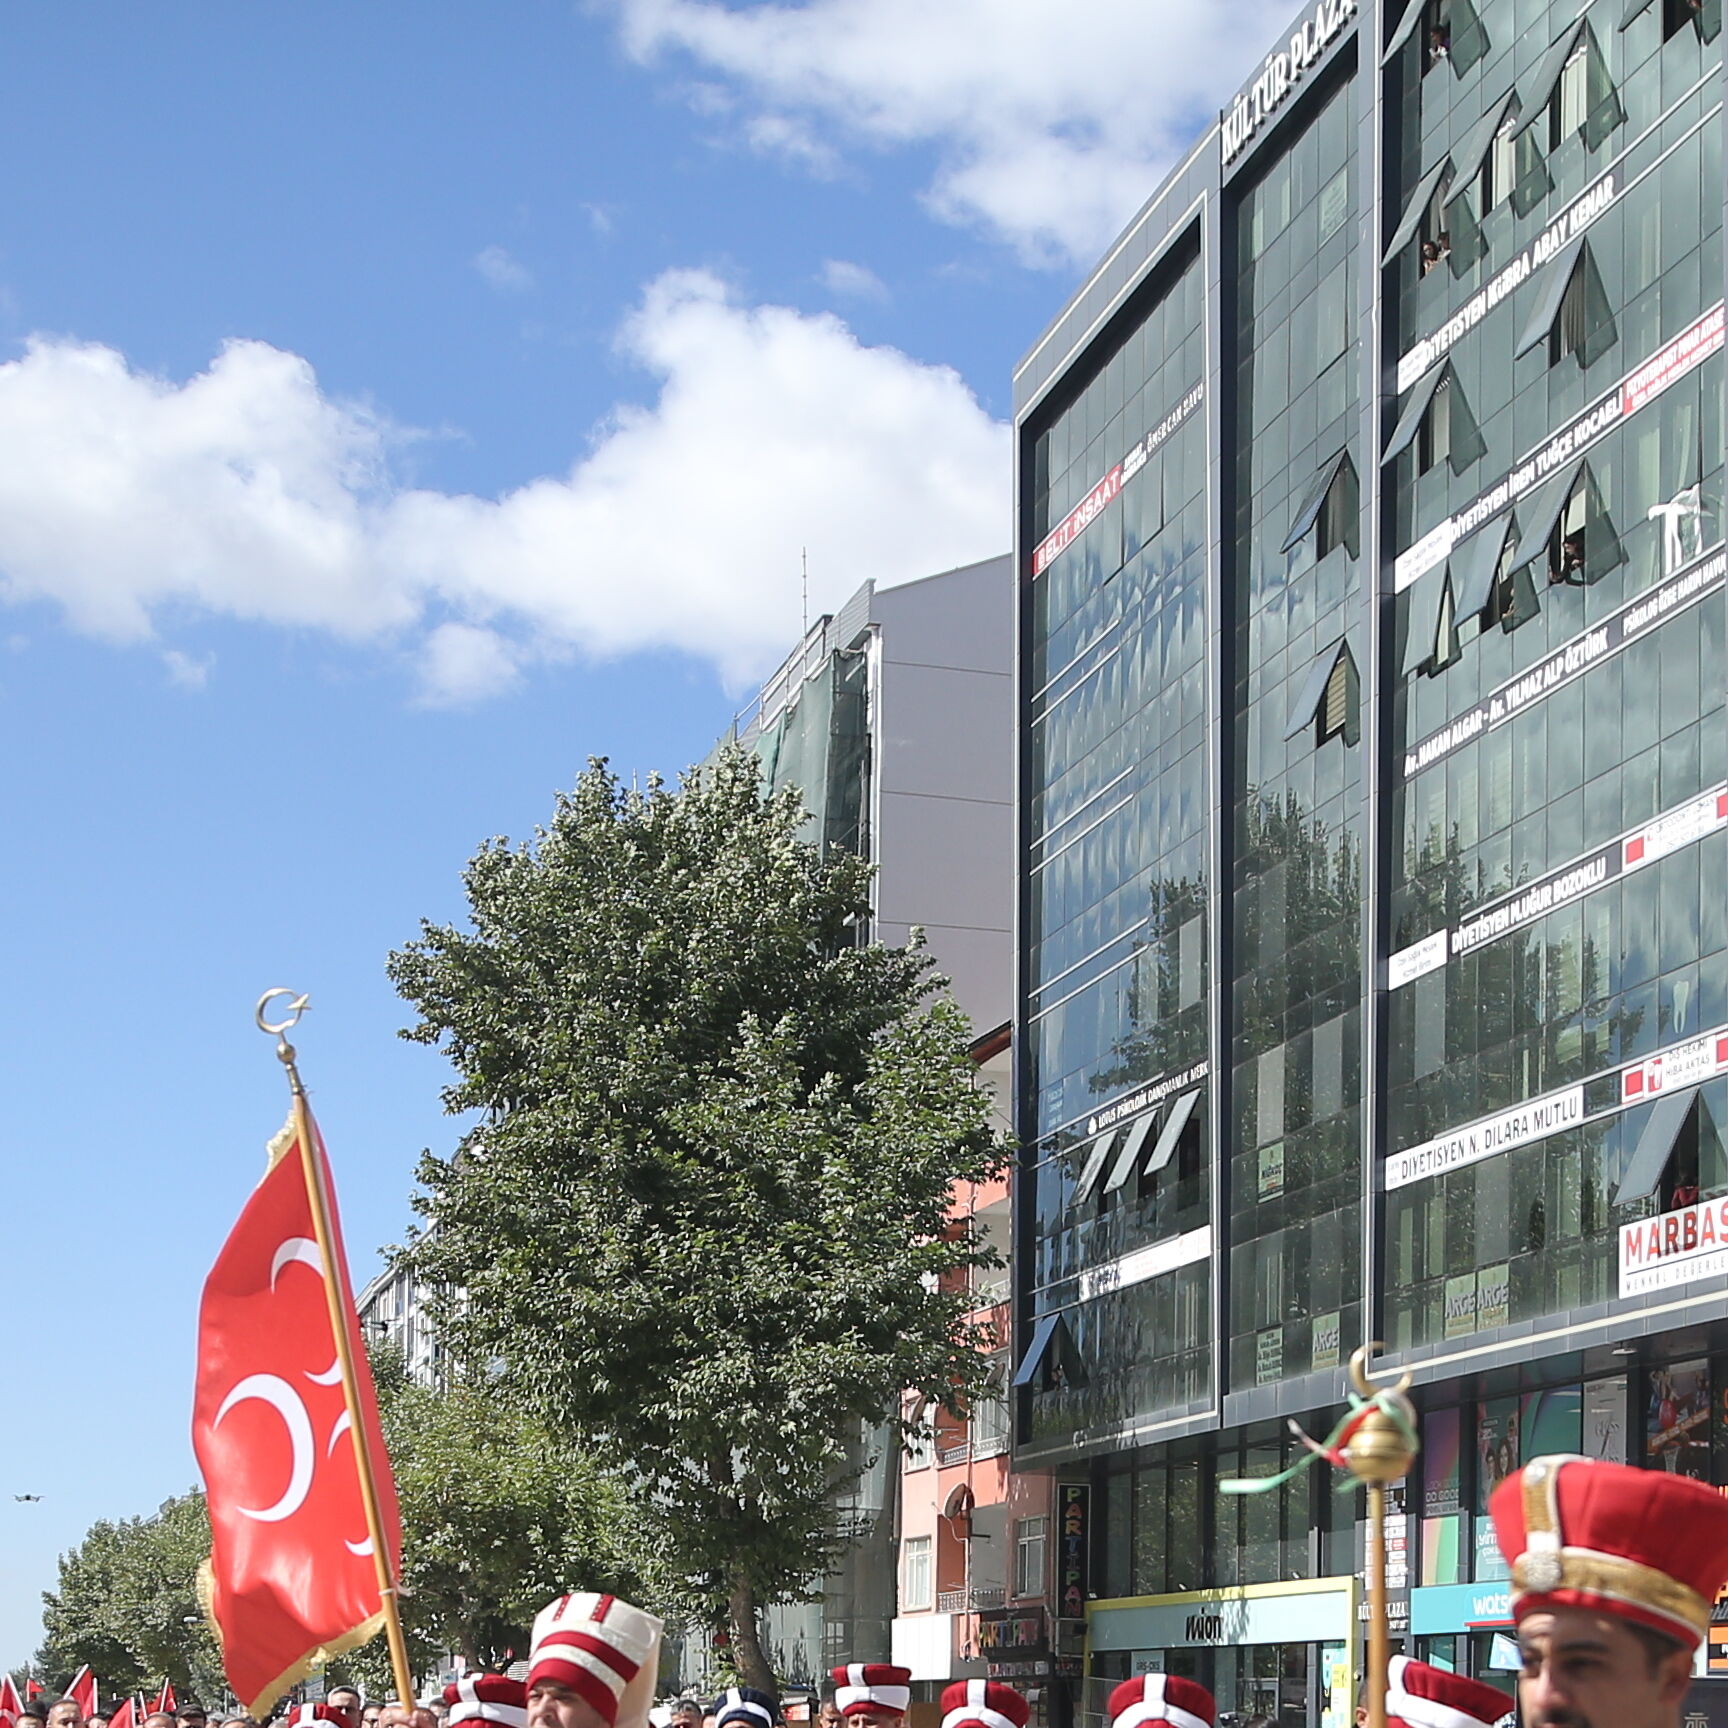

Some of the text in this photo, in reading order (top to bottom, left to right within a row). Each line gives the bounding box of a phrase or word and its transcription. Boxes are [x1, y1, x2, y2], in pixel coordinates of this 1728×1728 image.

[1221, 53, 1288, 165] KÜLTÜR
[1532, 215, 1568, 270] ABAY
[1570, 175, 1615, 236] KENAR
[1450, 482, 1508, 545] DİYETİSYEN
[1536, 432, 1573, 478] TUĞÇE
[1037, 523, 1072, 571] BELİT
[1451, 709, 1483, 754] ALGAR
[1505, 670, 1543, 713] YILMAZ
[1543, 661, 1564, 689] ALP
[1564, 627, 1609, 674] ÖZTÜRK
[1451, 903, 1509, 954] DİYETİSYEN
[1553, 856, 1607, 903] BOZOKLU
[1485, 1115, 1528, 1150] DİLARA
[1533, 1096, 1578, 1130] MUTLU
[1472, 1592, 1512, 1615] wats
